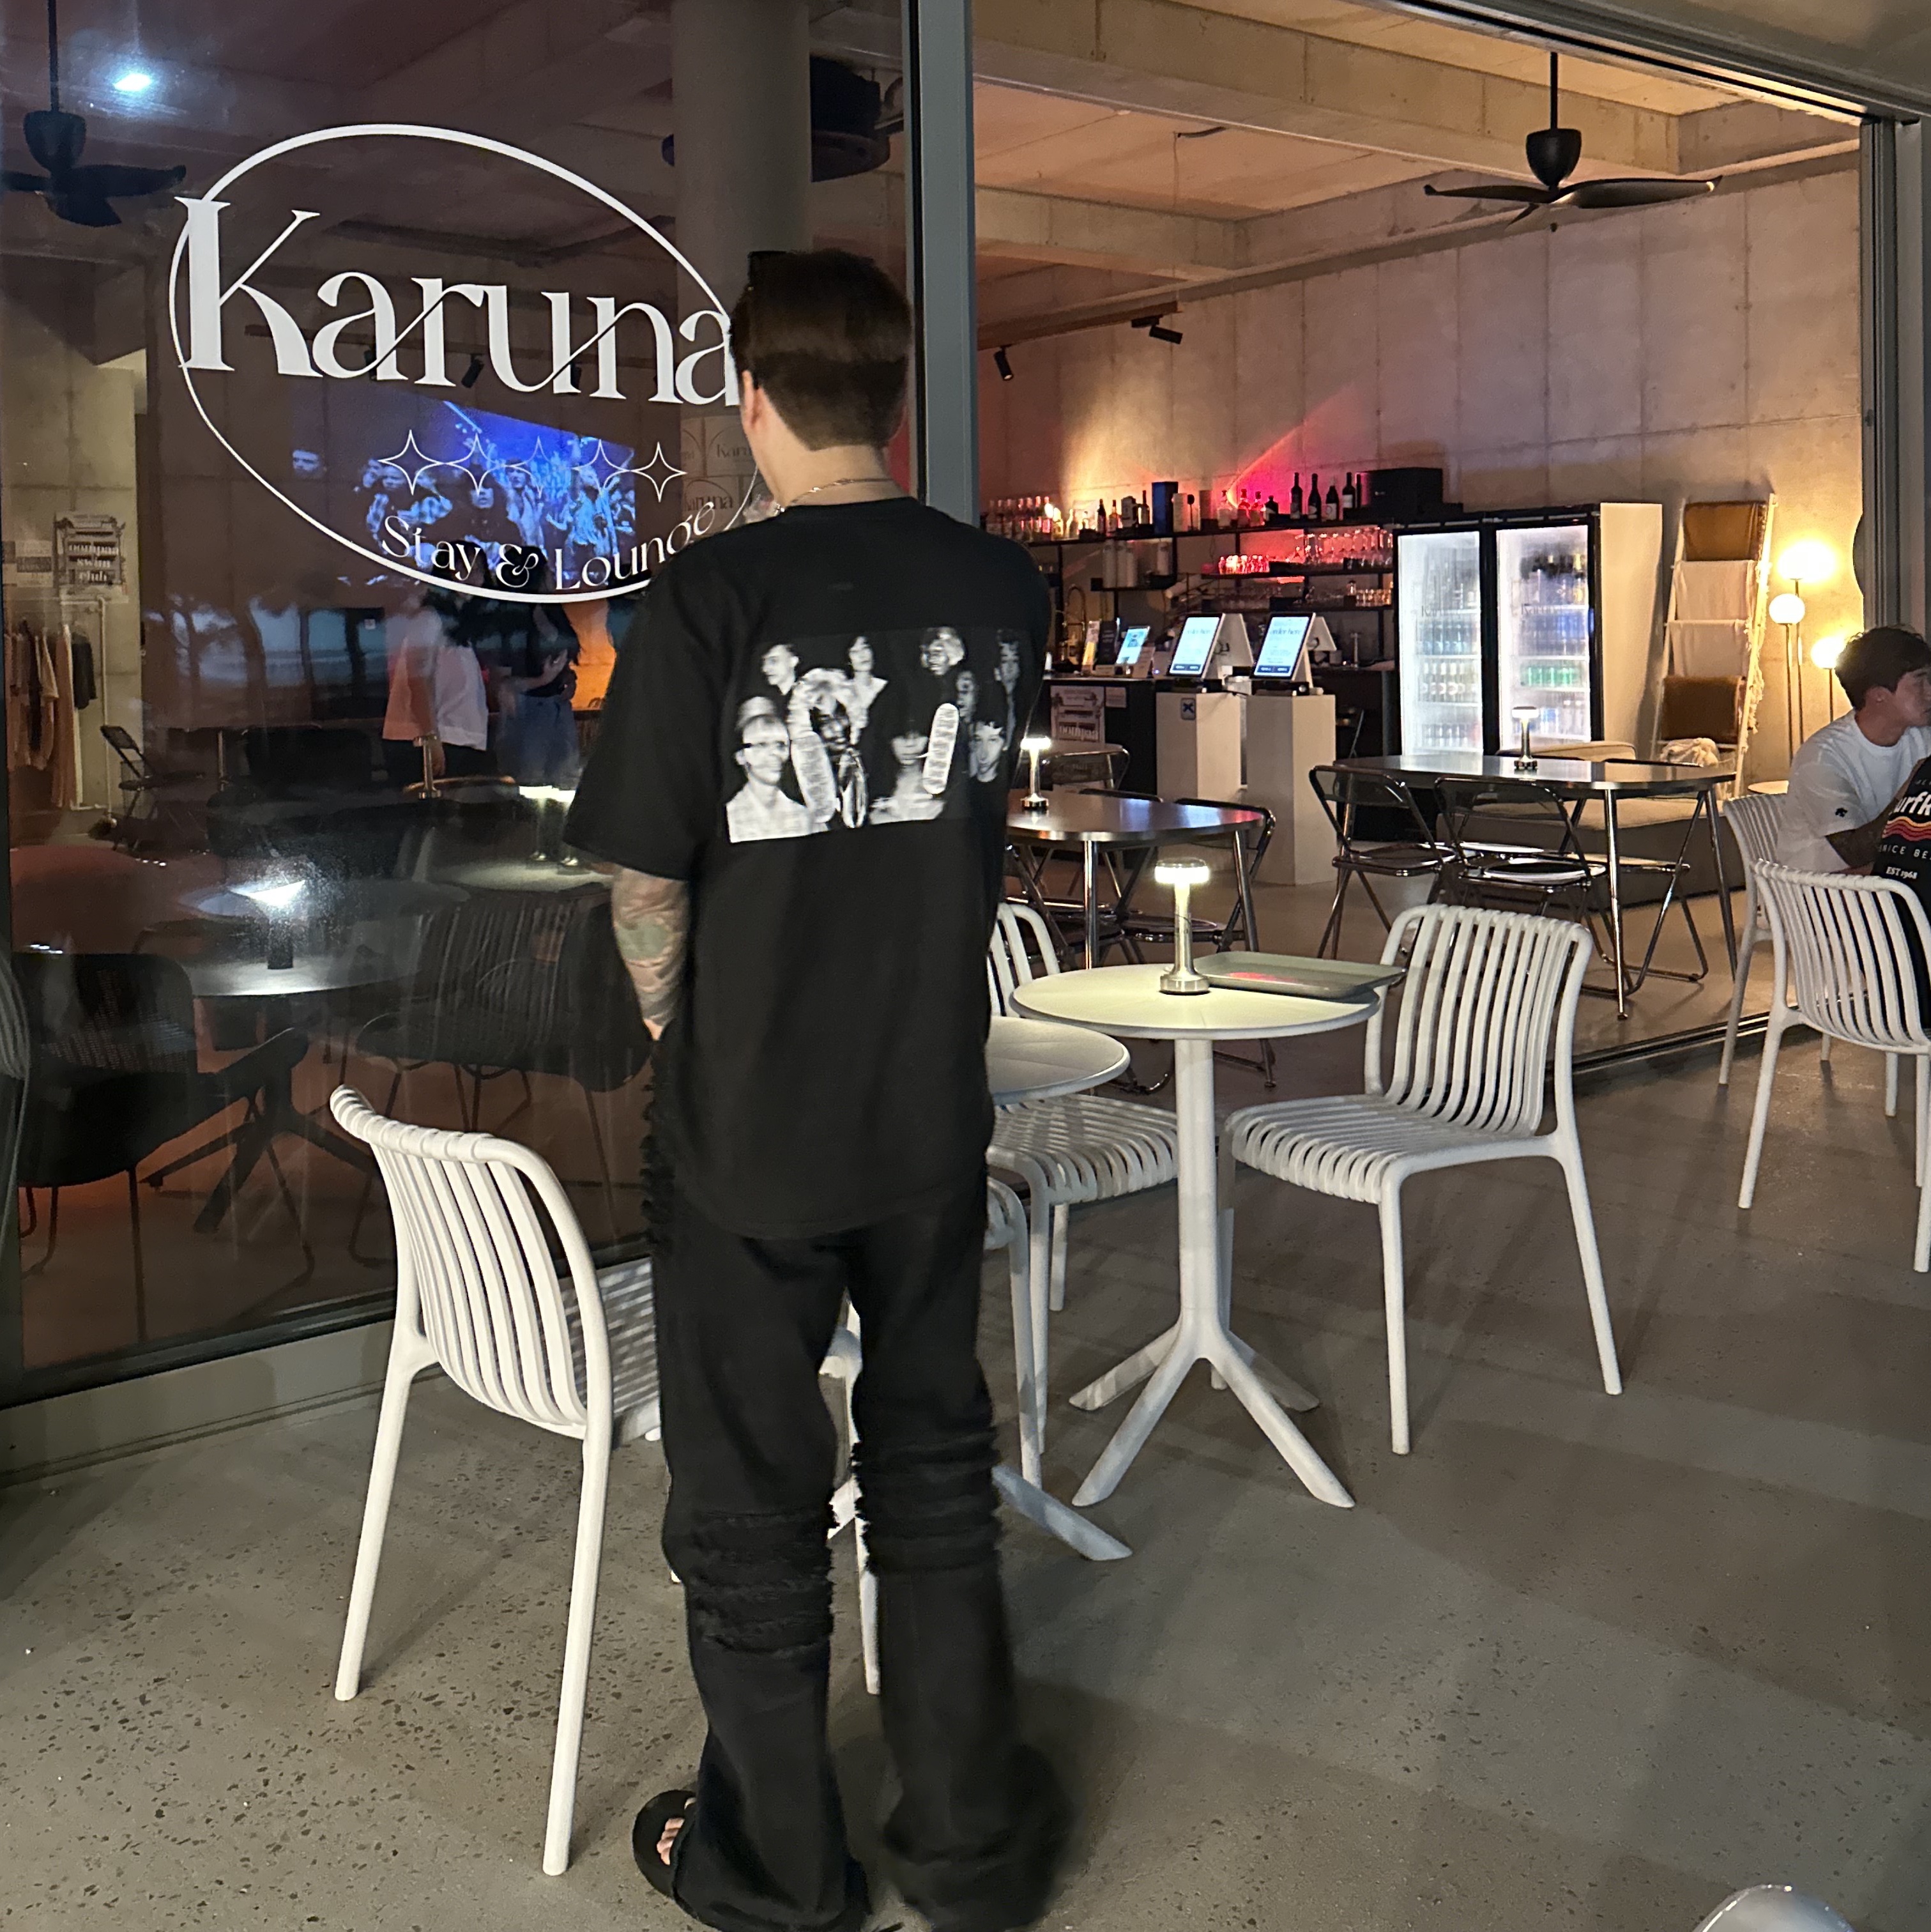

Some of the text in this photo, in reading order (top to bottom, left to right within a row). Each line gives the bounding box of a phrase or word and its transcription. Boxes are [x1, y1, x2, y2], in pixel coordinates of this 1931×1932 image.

[174, 195, 740, 406] Karuna
[382, 515, 480, 581] Stay
[496, 543, 538, 588] &
[1914, 848, 1931, 861] BE
